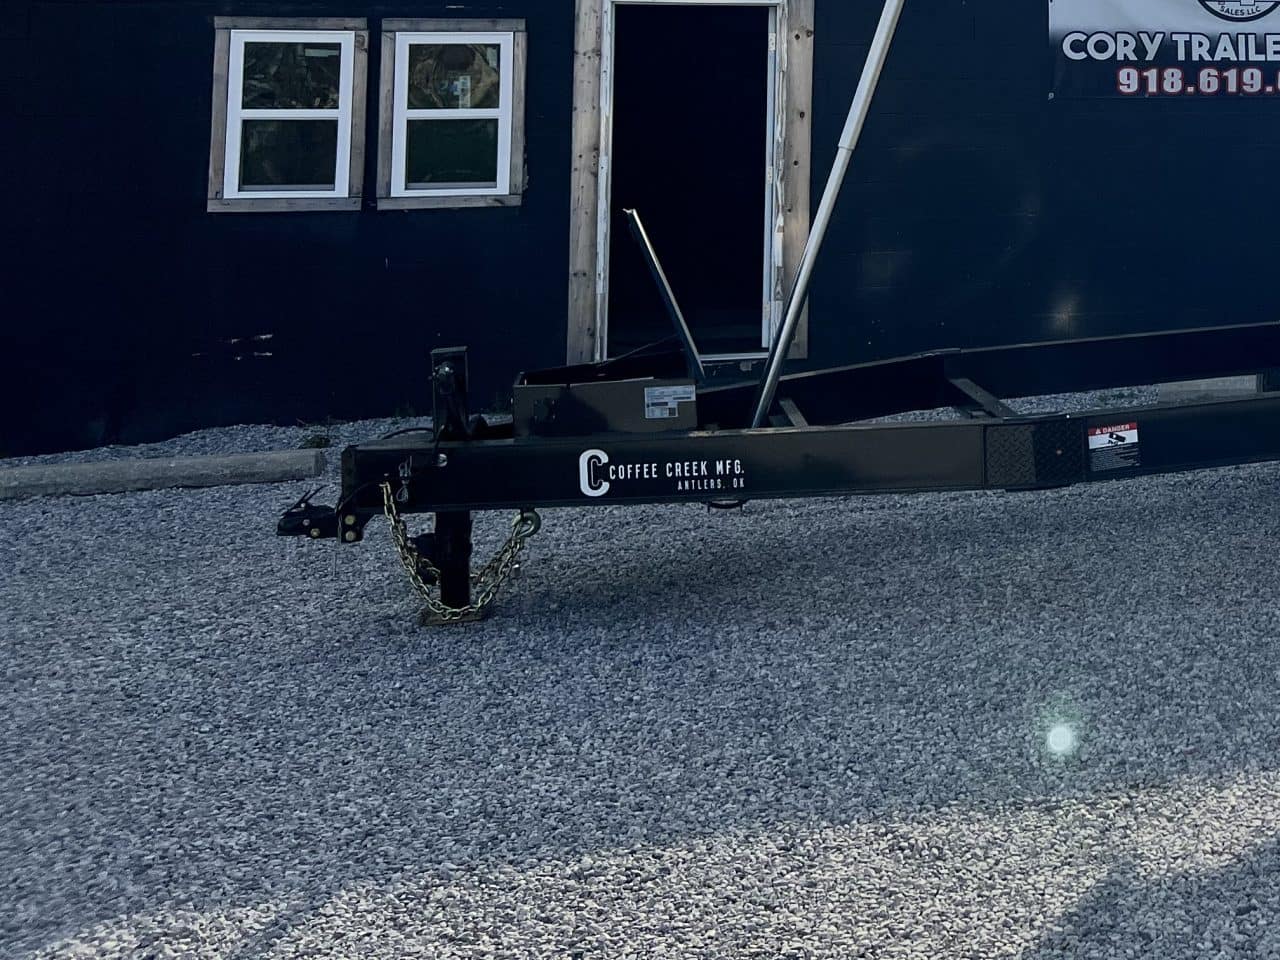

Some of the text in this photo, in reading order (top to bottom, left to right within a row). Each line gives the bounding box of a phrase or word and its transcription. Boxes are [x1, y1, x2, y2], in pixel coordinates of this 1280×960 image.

[1220, 5, 1261, 16] SALES LLC
[1061, 32, 1166, 61] CORY
[609, 459, 745, 480] COFFEE CREEK MFG.
[732, 477, 745, 489] OK
